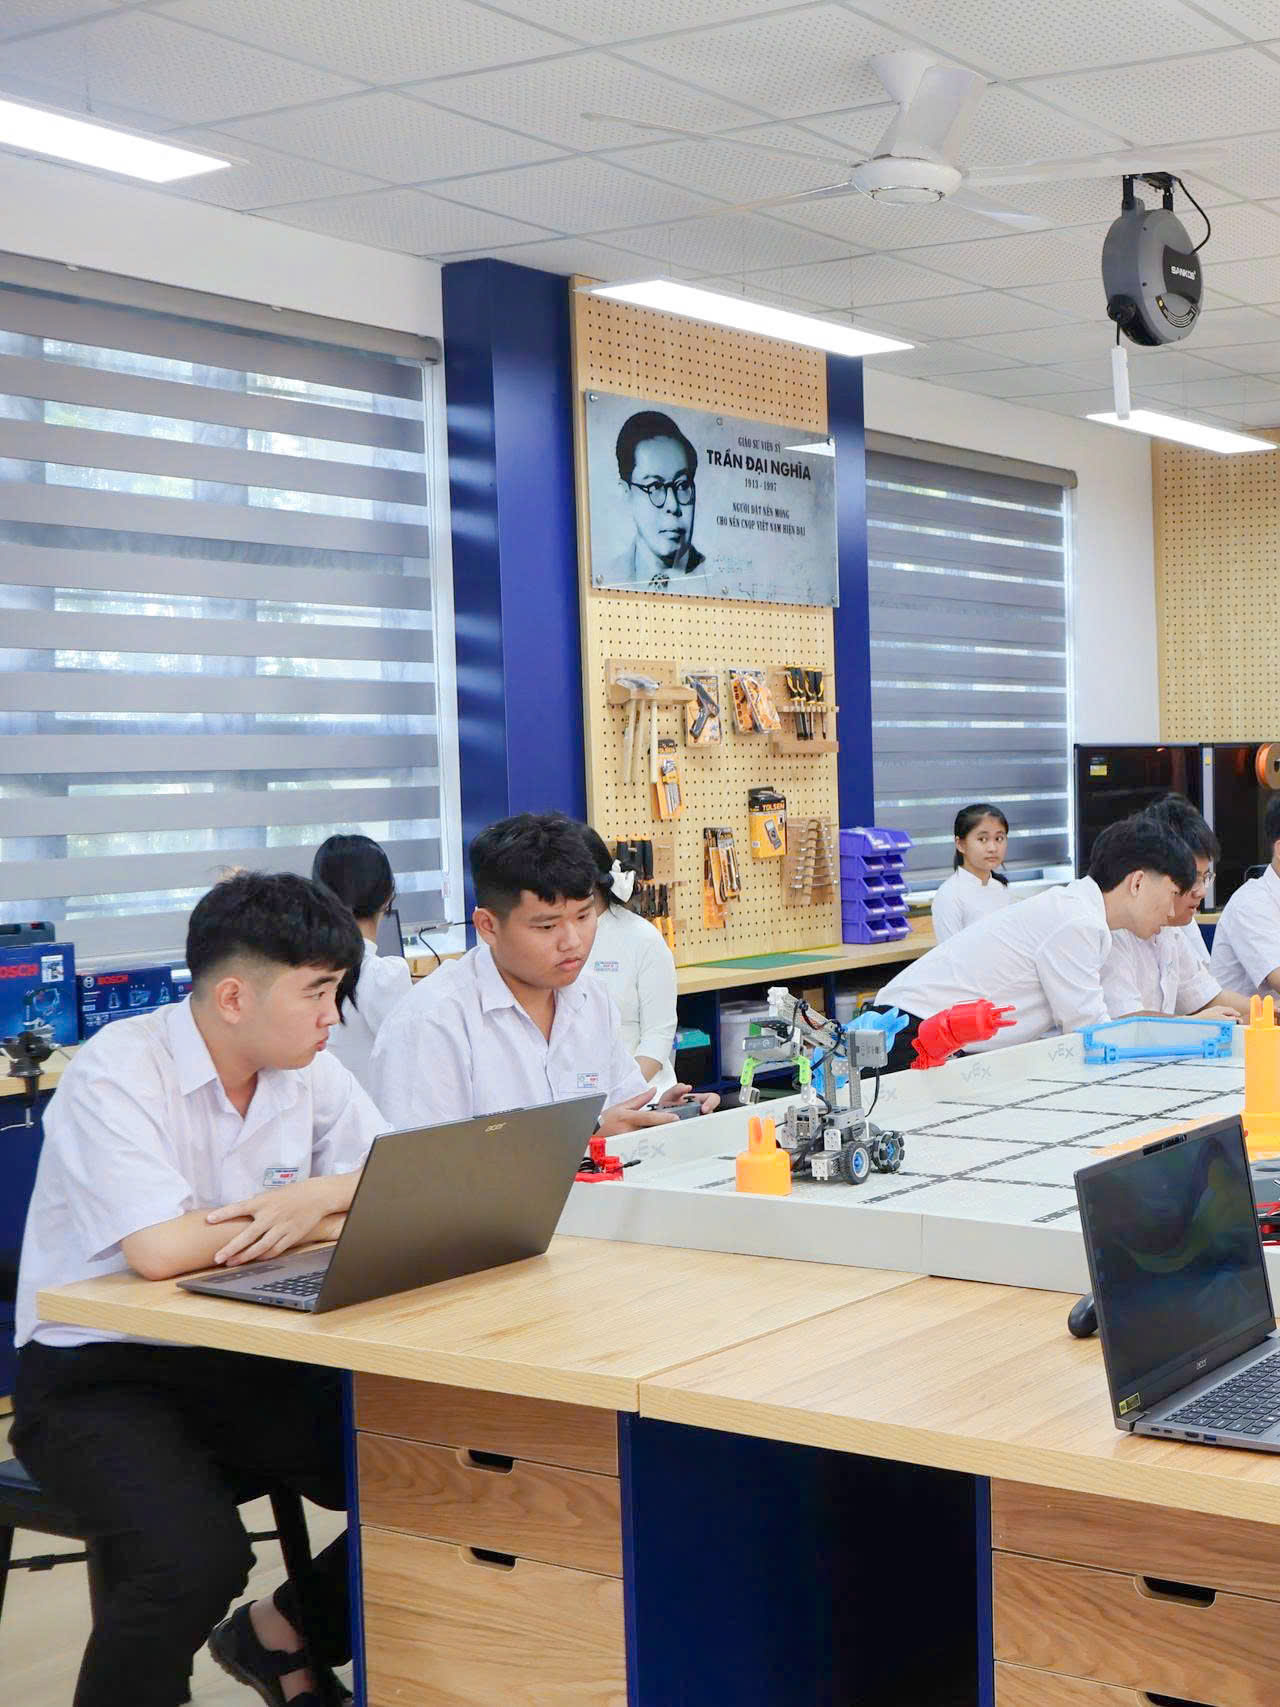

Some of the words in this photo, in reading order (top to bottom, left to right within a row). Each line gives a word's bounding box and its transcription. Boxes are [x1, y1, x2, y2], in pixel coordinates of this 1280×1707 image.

[745, 455, 768, 475] ĐẠI
[770, 460, 811, 481] NGHĨA
[745, 478, 759, 490] 1913
[762, 802, 785, 811] TOLSEN
[0, 964, 38, 979] OSCH
[1048, 1043, 1074, 1063] VEX
[961, 1062, 992, 1082] VEX
[485, 1122, 507, 1132] acer
